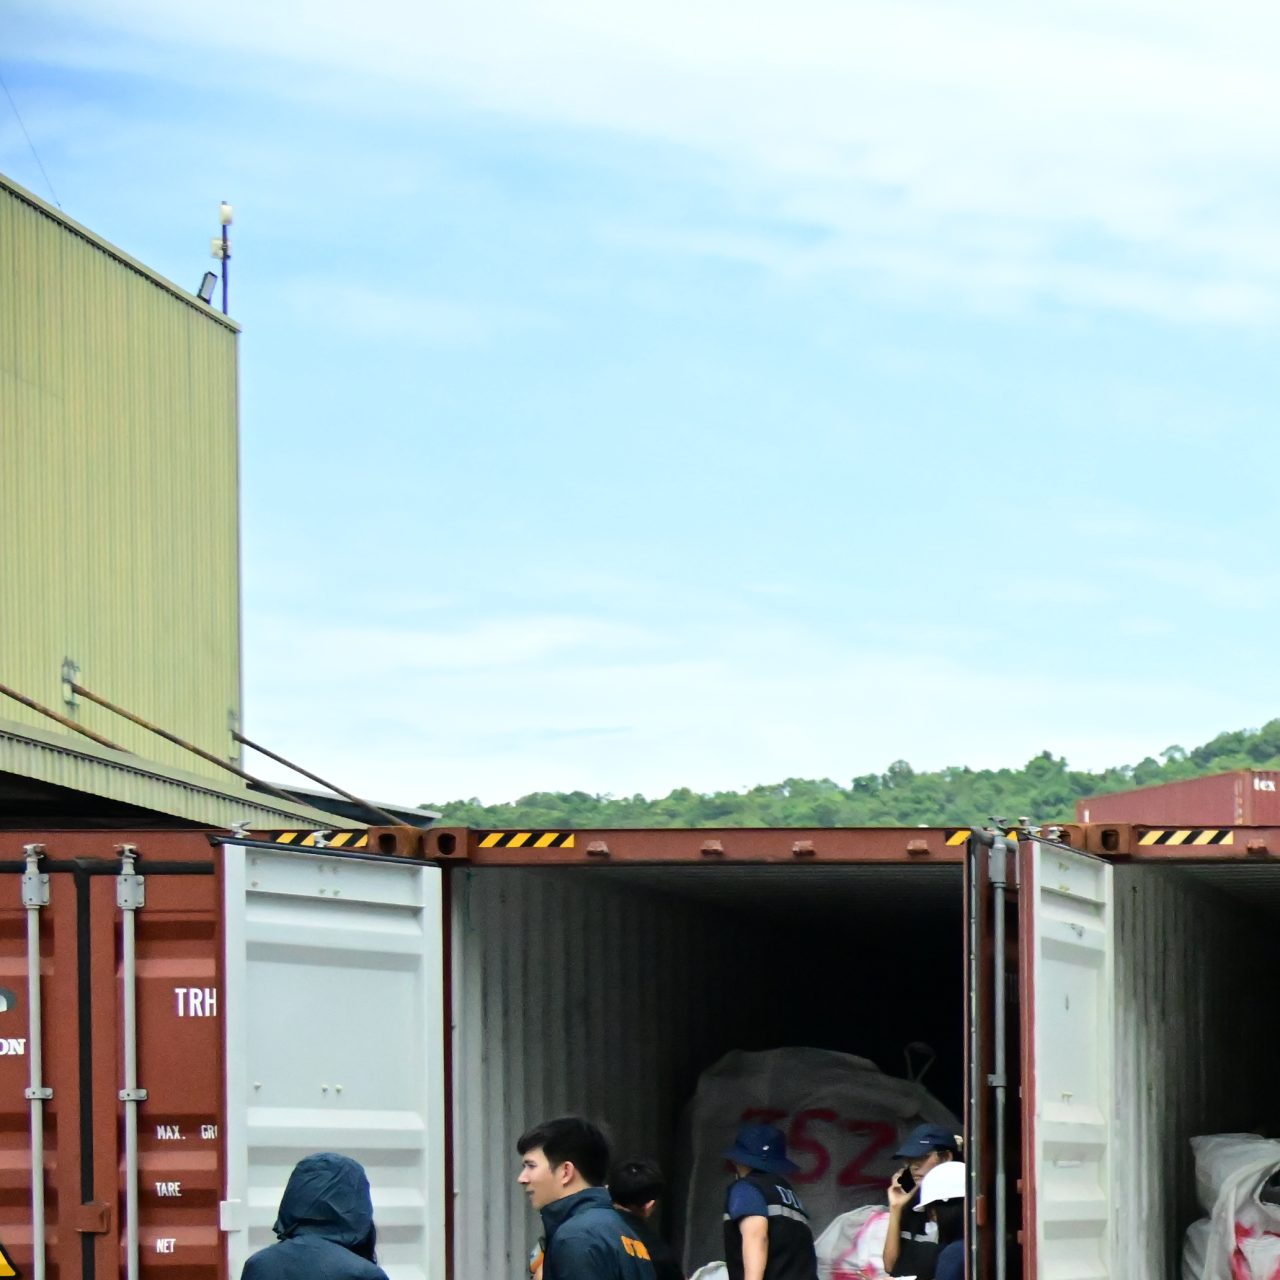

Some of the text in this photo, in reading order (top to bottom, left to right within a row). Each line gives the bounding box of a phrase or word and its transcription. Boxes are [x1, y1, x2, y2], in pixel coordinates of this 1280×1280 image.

[156, 1124, 218, 1140] MAX. GR
[155, 1182, 182, 1197] TARE
[156, 1238, 177, 1253] NET
